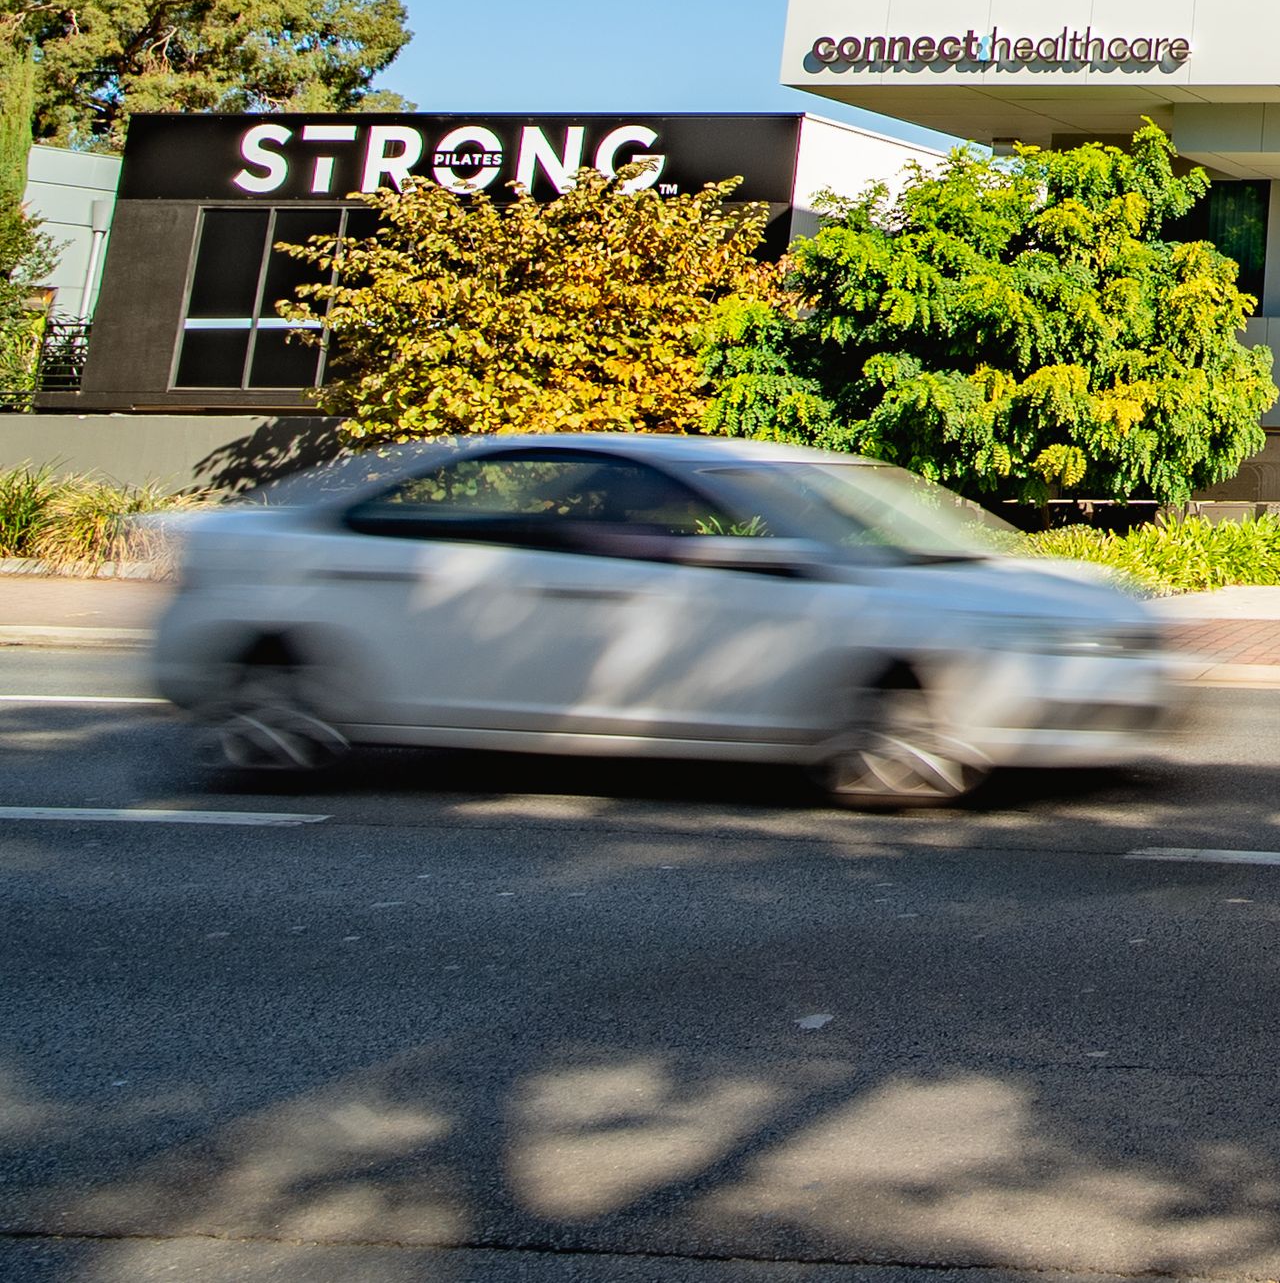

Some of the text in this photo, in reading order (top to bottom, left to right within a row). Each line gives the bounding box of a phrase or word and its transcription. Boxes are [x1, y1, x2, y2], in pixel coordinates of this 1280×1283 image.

[812, 26, 1192, 64] connect healthcare
[232, 124, 666, 196] STRONG
[433, 152, 503, 167] PILATES
[658, 183, 678, 195] TM
